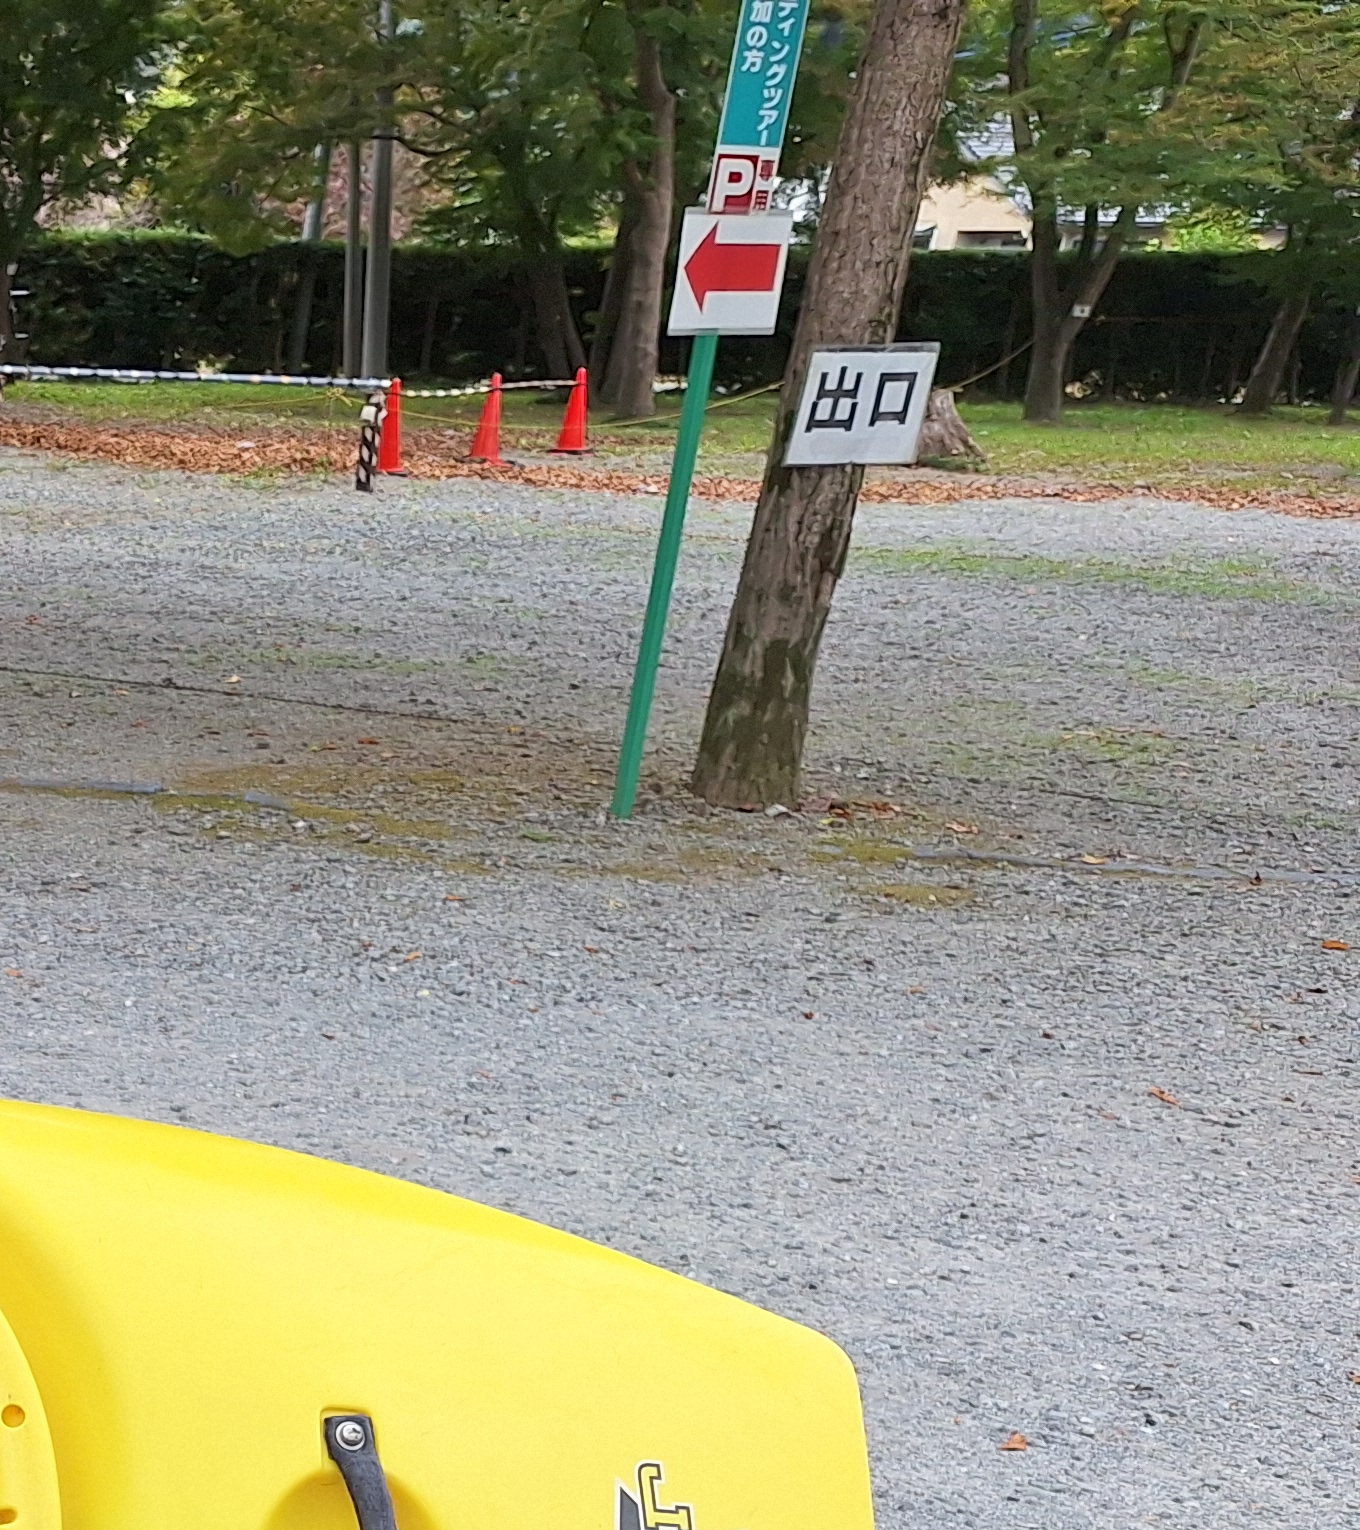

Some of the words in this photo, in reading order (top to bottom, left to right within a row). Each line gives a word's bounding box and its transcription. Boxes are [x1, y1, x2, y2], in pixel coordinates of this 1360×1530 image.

[741, 0, 774, 73] 加の方
[756, 0, 799, 146] ティングツアー
[709, 157, 755, 213] P
[804, 366, 918, 433] 出口
